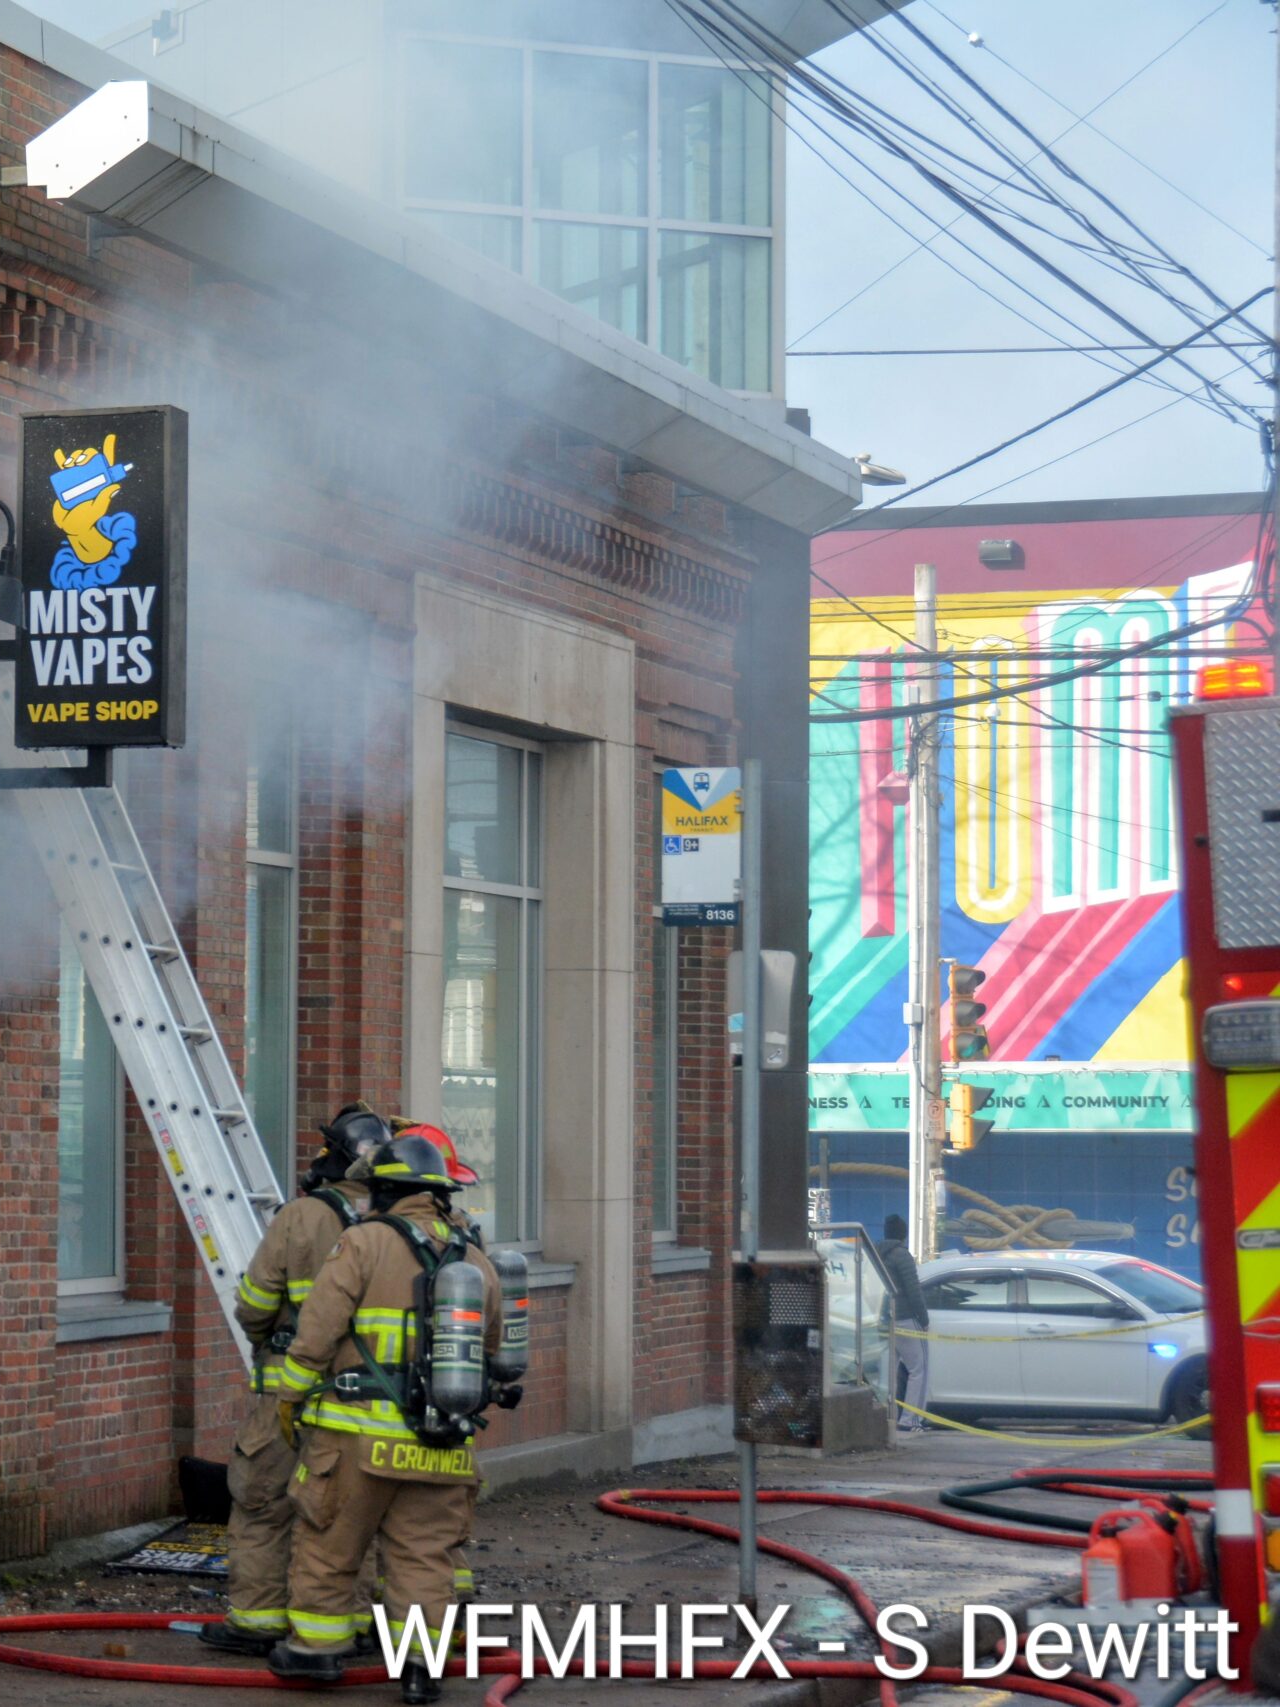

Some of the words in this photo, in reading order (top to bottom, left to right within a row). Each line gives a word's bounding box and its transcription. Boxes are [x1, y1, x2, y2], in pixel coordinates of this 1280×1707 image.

[30, 586, 156, 635] MISTY
[31, 636, 153, 687] VAPES
[27, 702, 90, 723] VAPE
[95, 700, 159, 721] SHOP
[675, 815, 729, 827] HALIFAX
[706, 909, 735, 921] 8136
[1062, 1095, 1170, 1109] COMMUNITY
[371, 1441, 387, 1466] C
